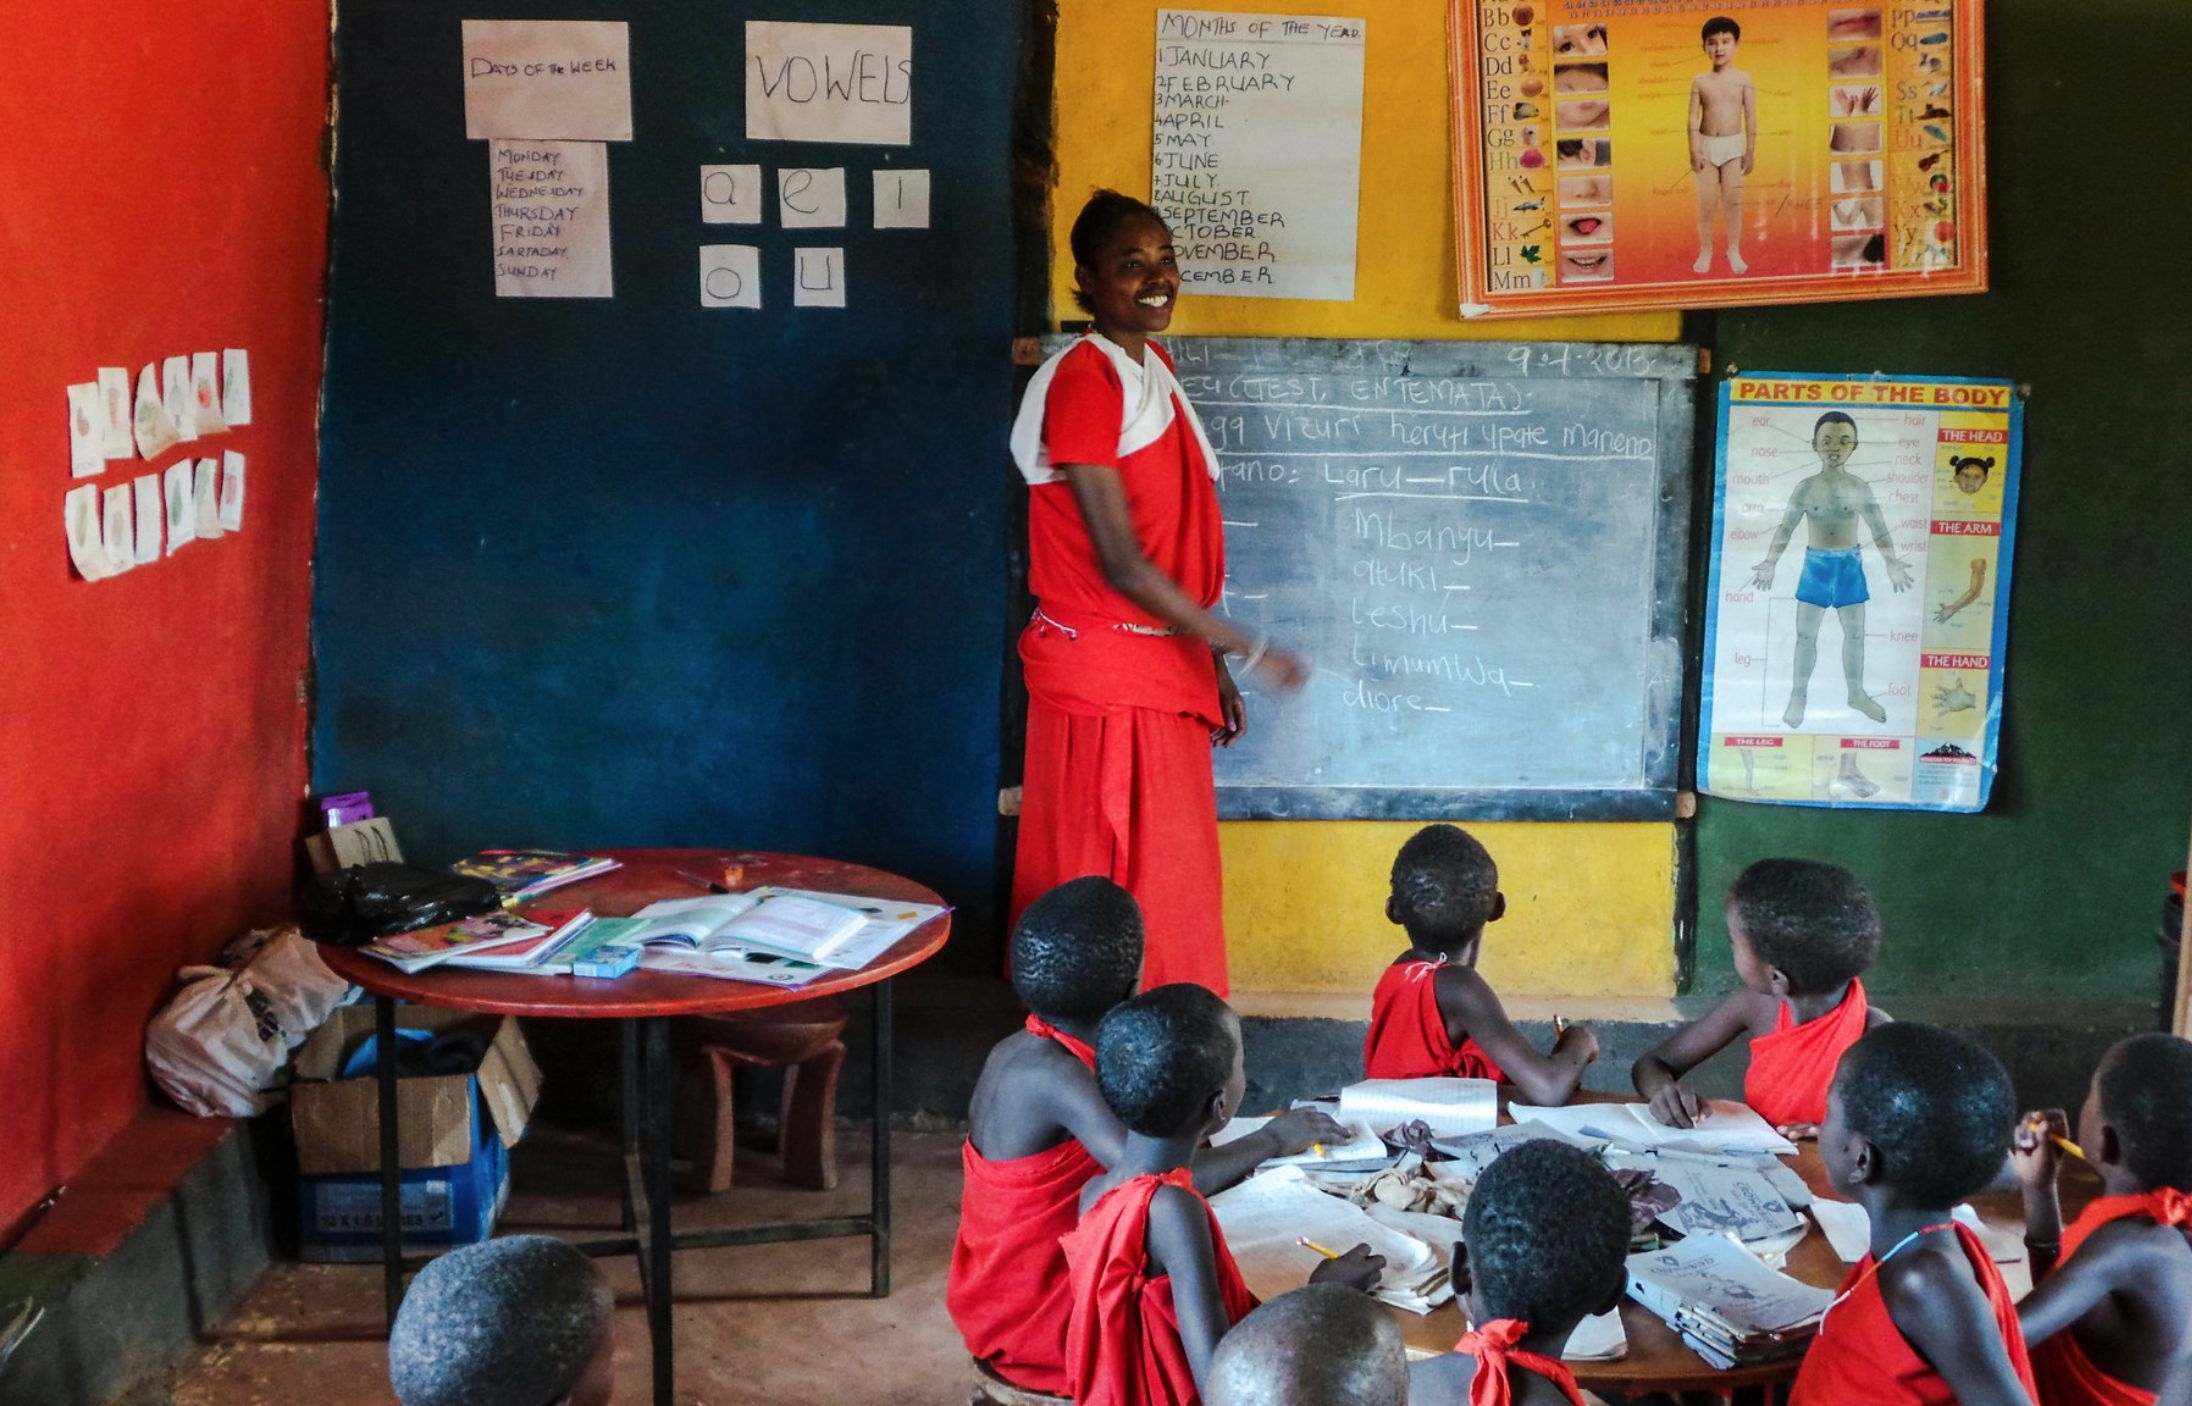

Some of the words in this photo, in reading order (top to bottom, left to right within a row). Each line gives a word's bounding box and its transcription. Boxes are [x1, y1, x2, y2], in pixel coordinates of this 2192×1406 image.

[1162, 13, 1237, 39] MONTHS
[1249, 21, 1272, 39] OF
[1282, 20, 1310, 37] THE
[524, 63, 546, 77] OF
[570, 58, 617, 73] WEEK
[756, 50, 912, 105] VOWELS
[498, 149, 561, 166] MONDAY
[704, 171, 737, 206] a
[783, 169, 820, 214] e
[494, 203, 580, 221] THURSDAY
[500, 223, 561, 242] FRIDAY
[1171, 223, 1256, 240] CTOBER
[1173, 241, 1276, 263] OVEMBER
[496, 264, 558, 280] SUNDAY
[1180, 266, 1274, 285] CEMBER
[1493, 271, 1532, 290] Mm
[1740, 382, 1822, 400] PARTS
[1831, 384, 1863, 401] OF
[1873, 386, 1924, 403] THE
[1934, 388, 2005, 405] BODY
[1903, 412, 1926, 427] hair
[1943, 430, 1967, 441] THE
[1969, 431, 2003, 442] HEAD
[1751, 447, 1779, 458] nose
[1895, 452, 1922, 466] neck
[1732, 472, 1771, 486] mouth
[1887, 470, 1929, 484] shoulder
[1888, 489, 1920, 505] chest
[1901, 517, 1928, 529] waist
[1938, 522, 1963, 533] THE
[1965, 523, 1992, 534] ARM
[1900, 540, 1927, 553] wrist
[1725, 591, 1754, 603] hand
[1889, 630, 1919, 643] knee
[1734, 653, 1752, 667] leg
[1928, 656, 1950, 667] THE
[1952, 657, 1988, 668] HAND
[1887, 682, 1913, 697] foot
[1735, 738, 1755, 746] THE
[1756, 738, 1774, 746] LEG
[1852, 740, 1868, 748] THE
[1869, 740, 1890, 748] FOOT
